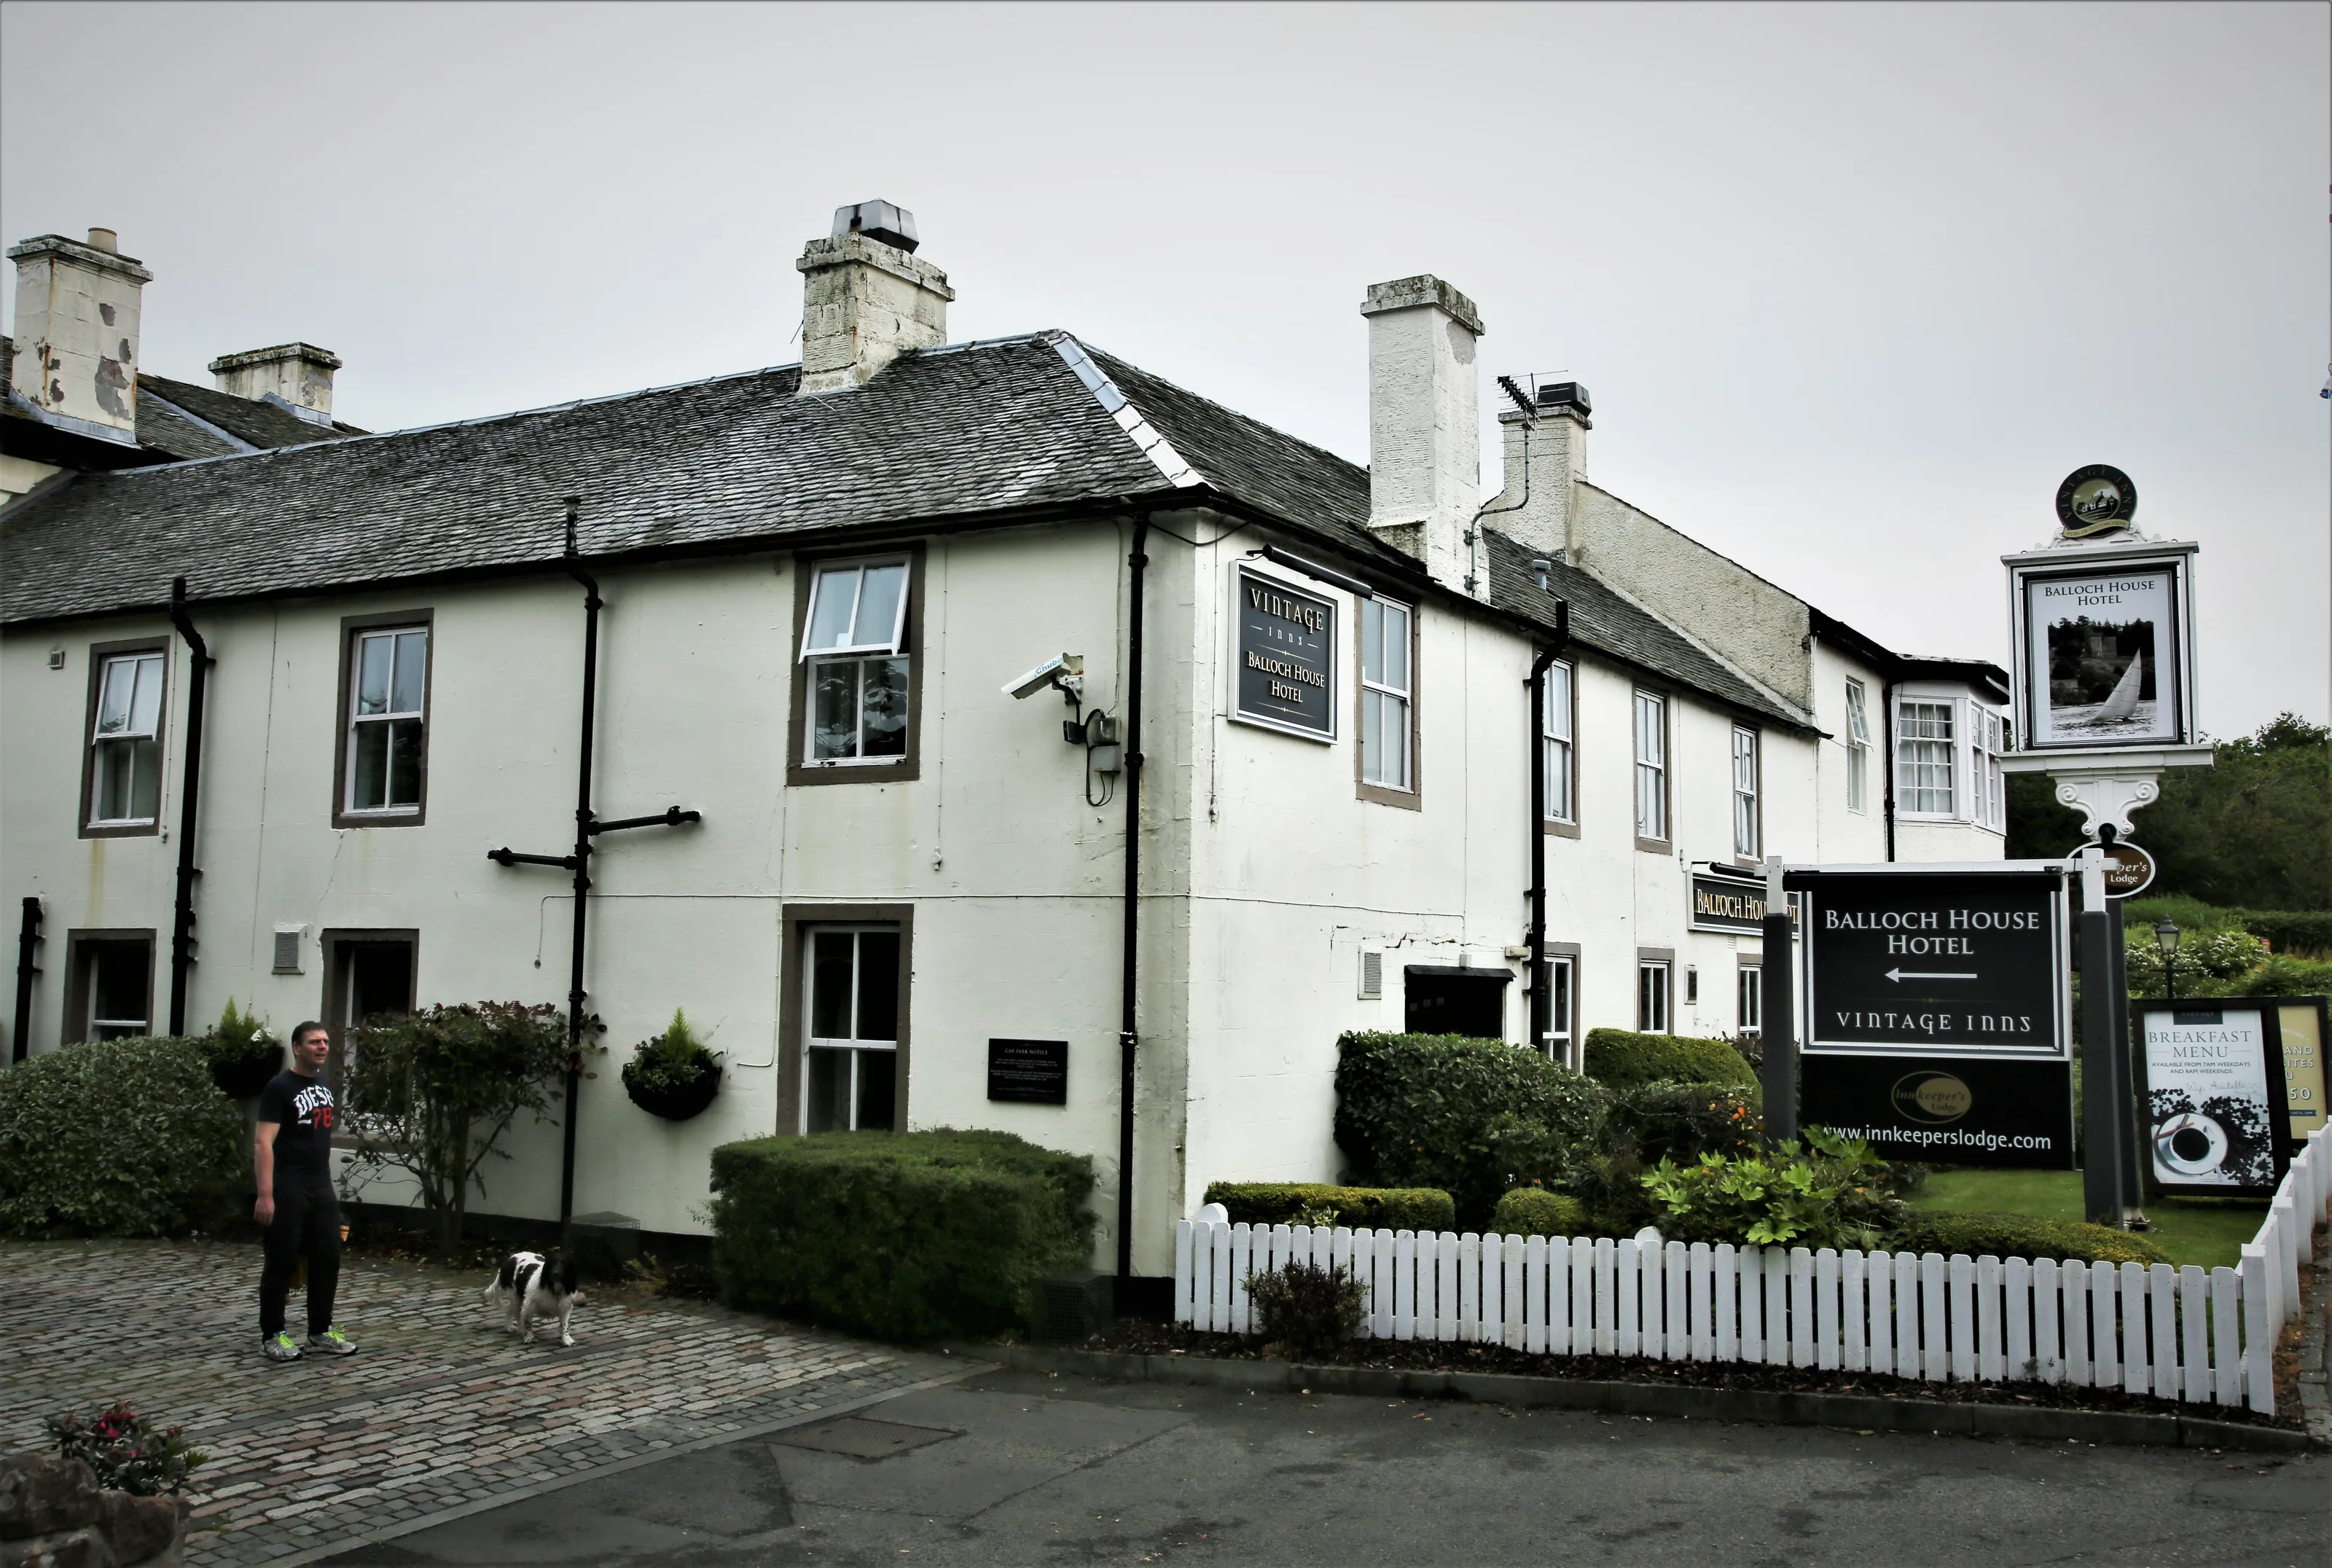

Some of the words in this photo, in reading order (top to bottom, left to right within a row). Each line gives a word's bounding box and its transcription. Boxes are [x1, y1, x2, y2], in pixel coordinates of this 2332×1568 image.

[2089, 521, 2126, 531] DISTINCTION
[2045, 584, 2104, 597] BALLOCH
[2108, 580, 2155, 592] HOUSE
[2078, 595, 2122, 605] HOTEL
[1249, 587, 1323, 634] VINTAGE
[1248, 651, 1291, 678] BALLOCH
[1294, 665, 1325, 688] HOUSE
[1270, 680, 1303, 703] HOTEL
[2110, 874, 2138, 885] Lodge
[1697, 888, 1742, 918] BALLOCH
[1745, 895, 1766, 920] HOU
[1825, 909, 1939, 930] BALLOCH
[1949, 909, 2040, 930] HOUSE
[1887, 935, 1974, 954] HOTEL
[1836, 1012, 1952, 1034] VINTAGE
[2148, 1031, 2252, 1043] BREAKFAST
[2173, 1046, 2229, 1058] MENU
[2284, 1046, 2313, 1054] AND
[293, 1084, 334, 1119] DIESE
[1895, 1089, 1965, 1102] Innkeeper's
[1932, 1103, 1957, 1113] Lodge
[1822, 1124, 2051, 1151] wwinnkeeperslodge.com
